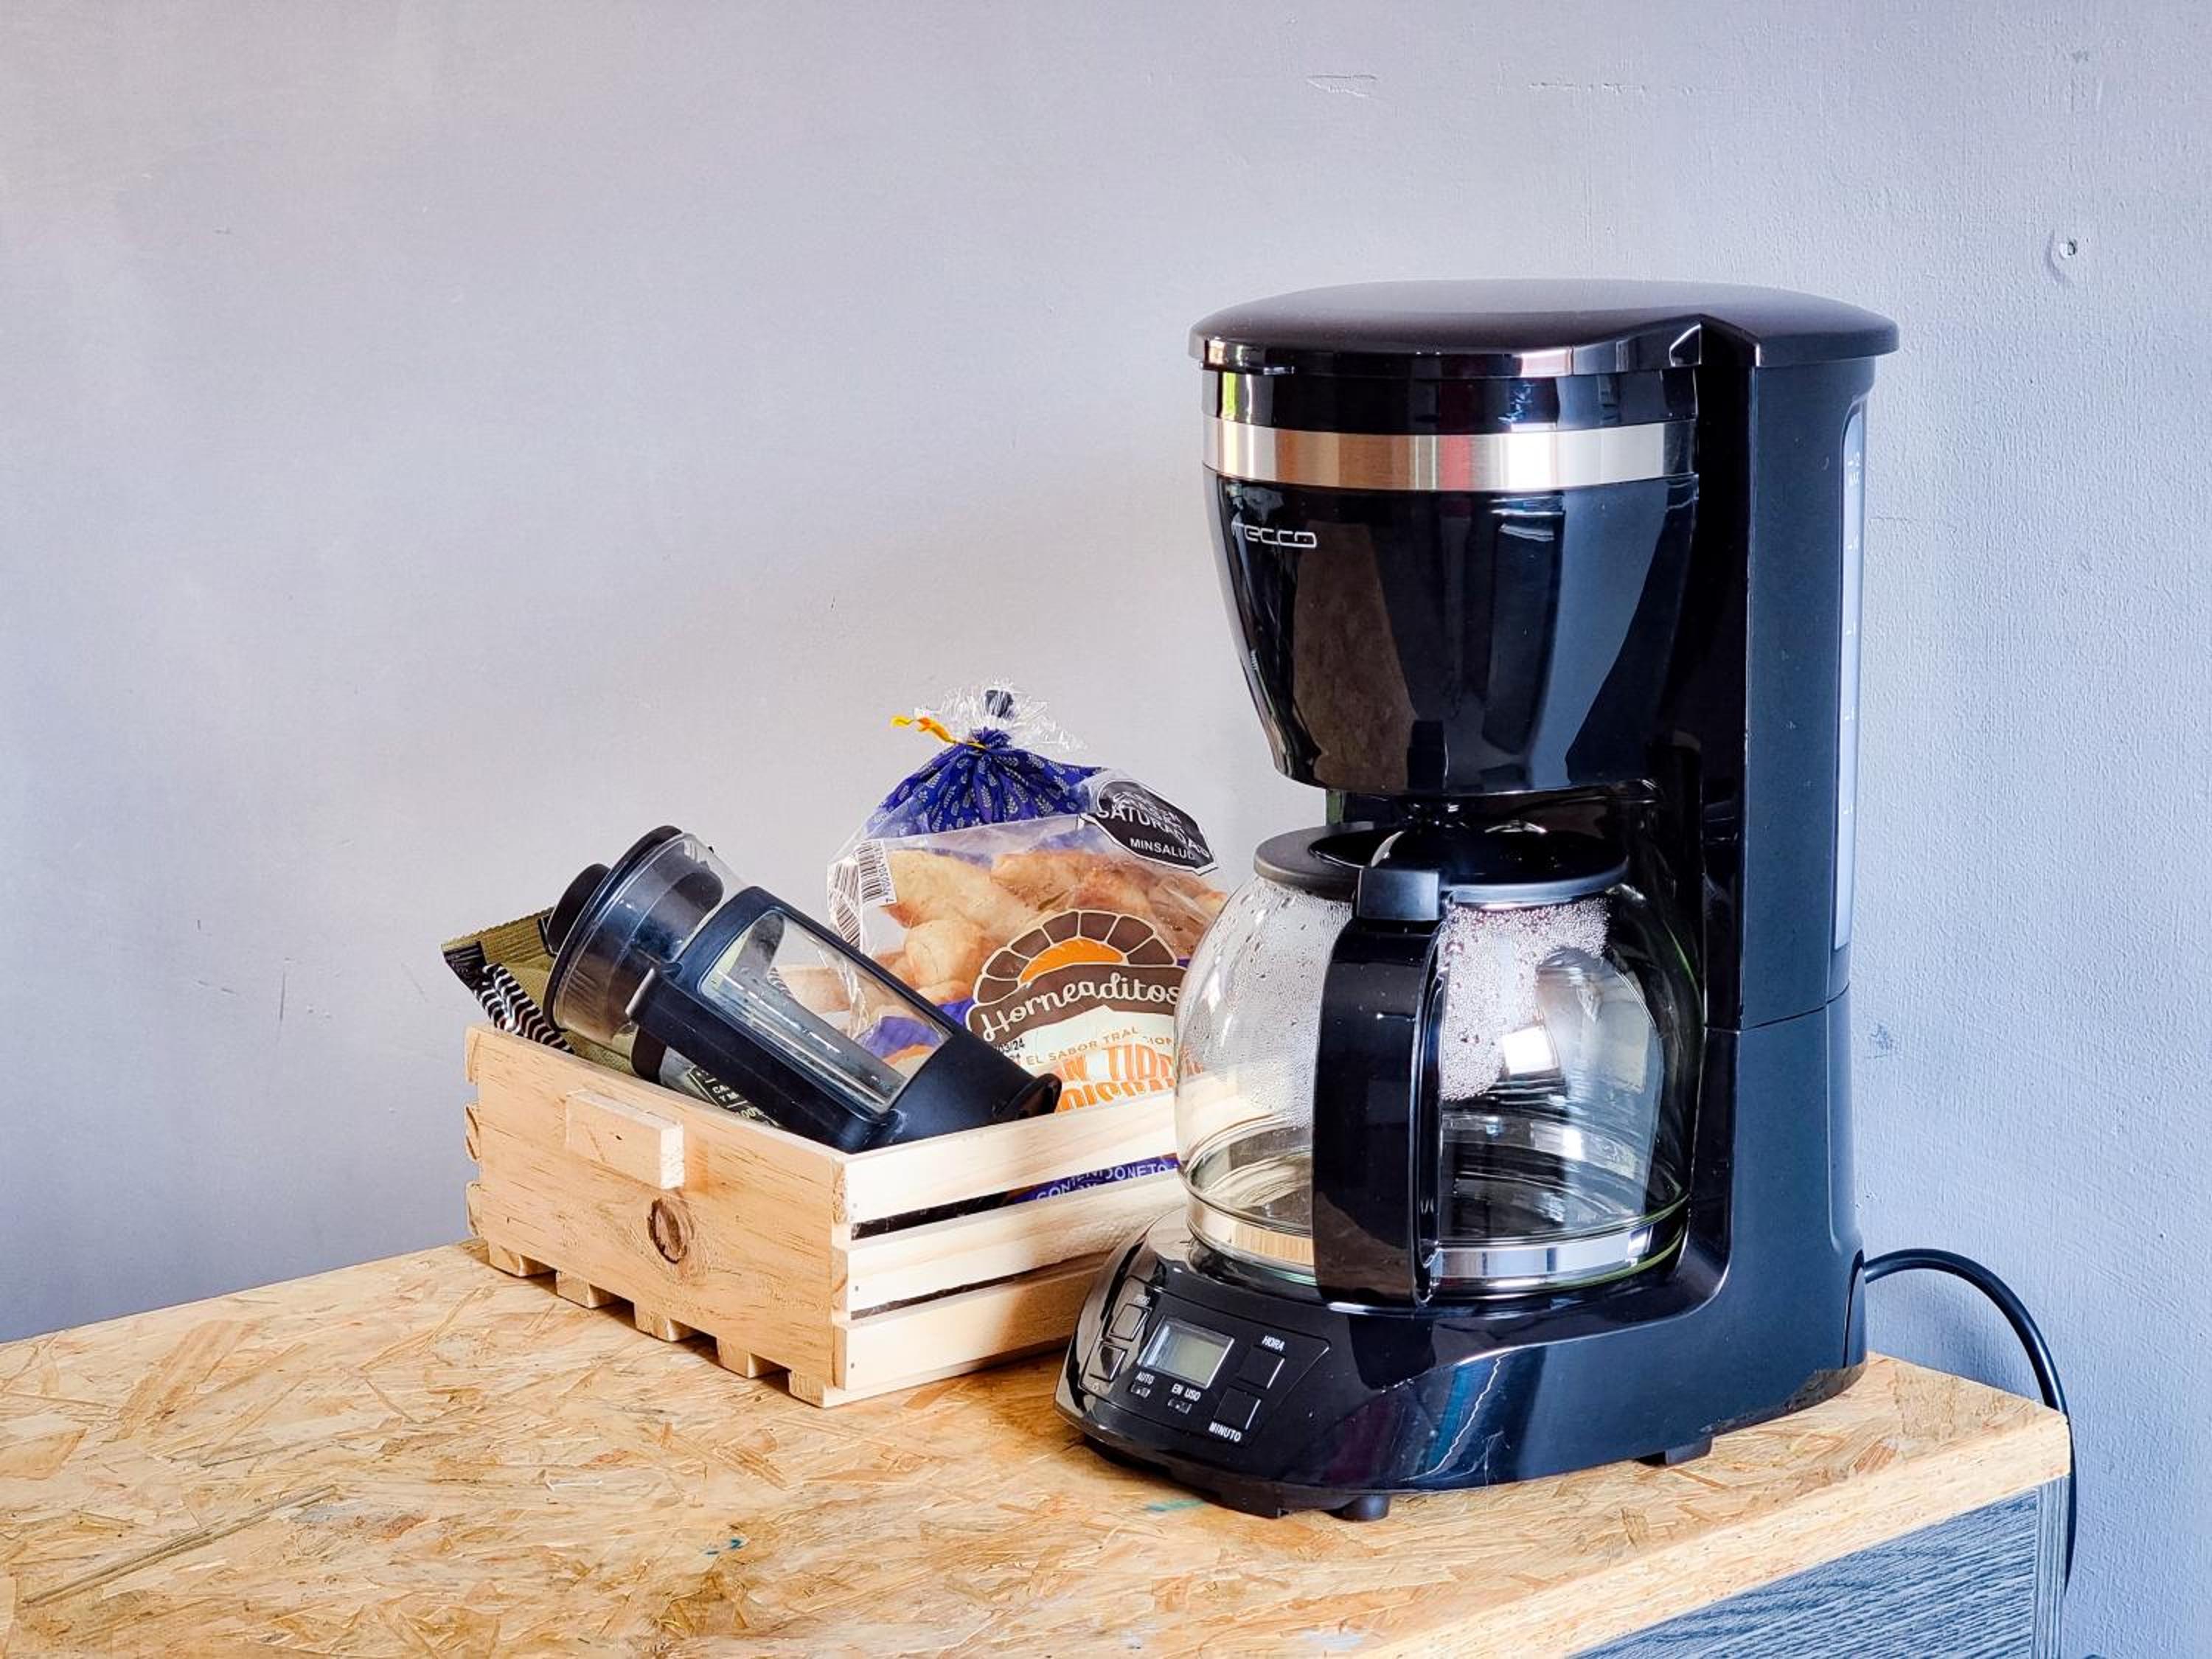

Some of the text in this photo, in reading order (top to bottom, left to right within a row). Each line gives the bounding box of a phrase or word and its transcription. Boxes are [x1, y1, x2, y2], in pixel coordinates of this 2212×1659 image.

[1130, 838, 1196, 860] MINSALUD
[981, 972, 1180, 1041] Horneaditos
[1049, 1040, 1098, 1060] SABOR
[1262, 1335, 1284, 1352] HORA
[1135, 1371, 1155, 1385] AUTO
[1172, 1383, 1201, 1402] EN USO
[1208, 1422, 1242, 1442] MINUTO
